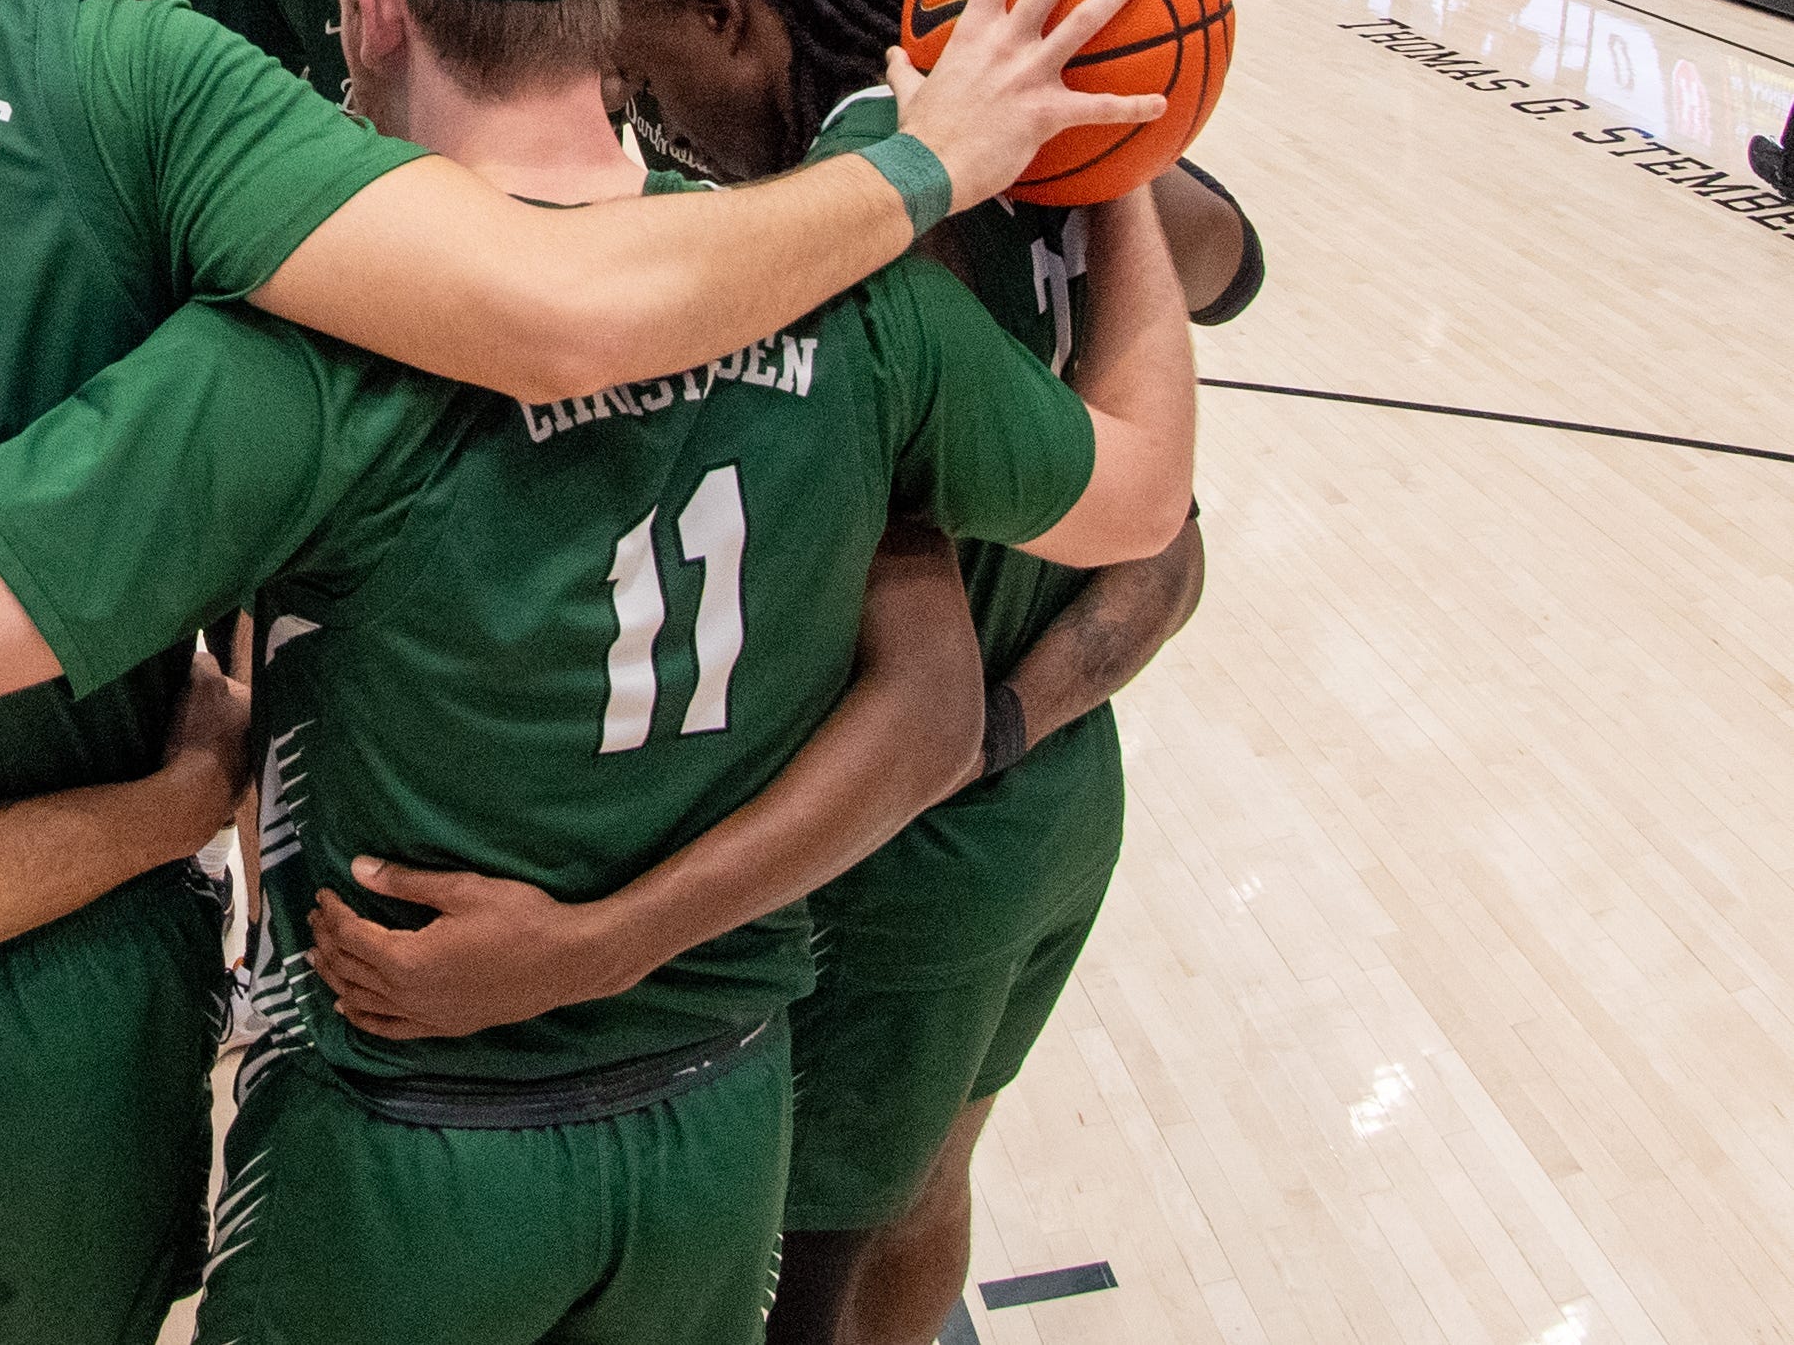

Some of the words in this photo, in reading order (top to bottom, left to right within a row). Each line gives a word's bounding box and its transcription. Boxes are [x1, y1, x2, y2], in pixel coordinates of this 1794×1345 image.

[1337, 17, 1530, 92] THOMAS
[1511, 97, 1590, 120] G.
[599, 464, 748, 754] 11
